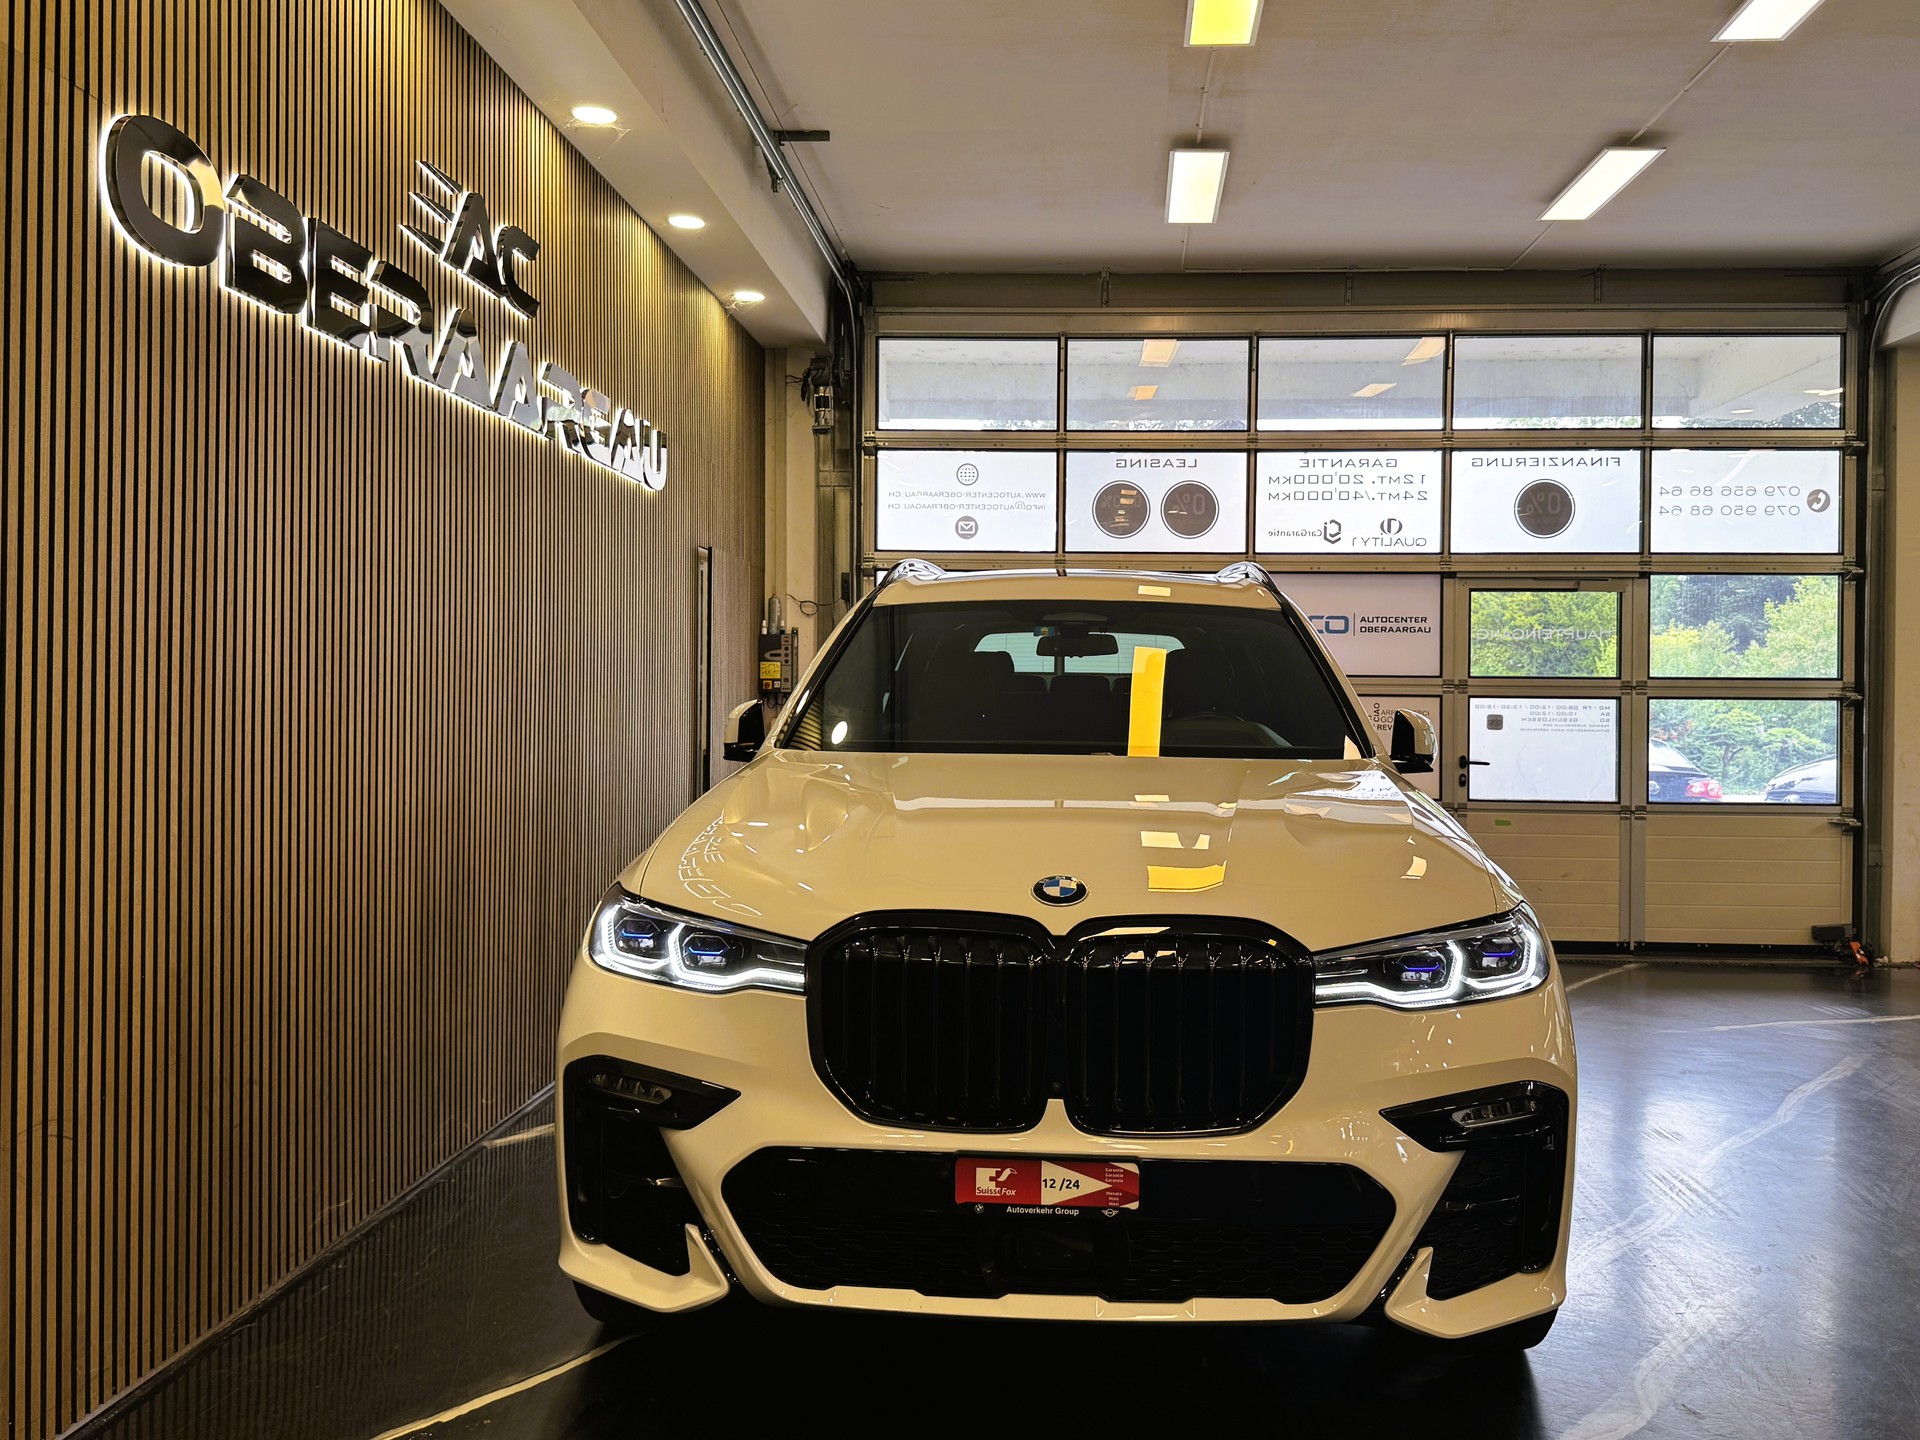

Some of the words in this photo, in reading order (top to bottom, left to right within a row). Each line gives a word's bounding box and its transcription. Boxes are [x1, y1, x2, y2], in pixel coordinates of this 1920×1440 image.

[99, 112, 669, 493] OBERAARGAU
[1359, 626, 1431, 634] OBERAARGAU
[1042, 1178, 1056, 1188] 12
[1006, 1205, 1053, 1214] Autoverkehr
[1055, 1207, 1079, 1216] Group
